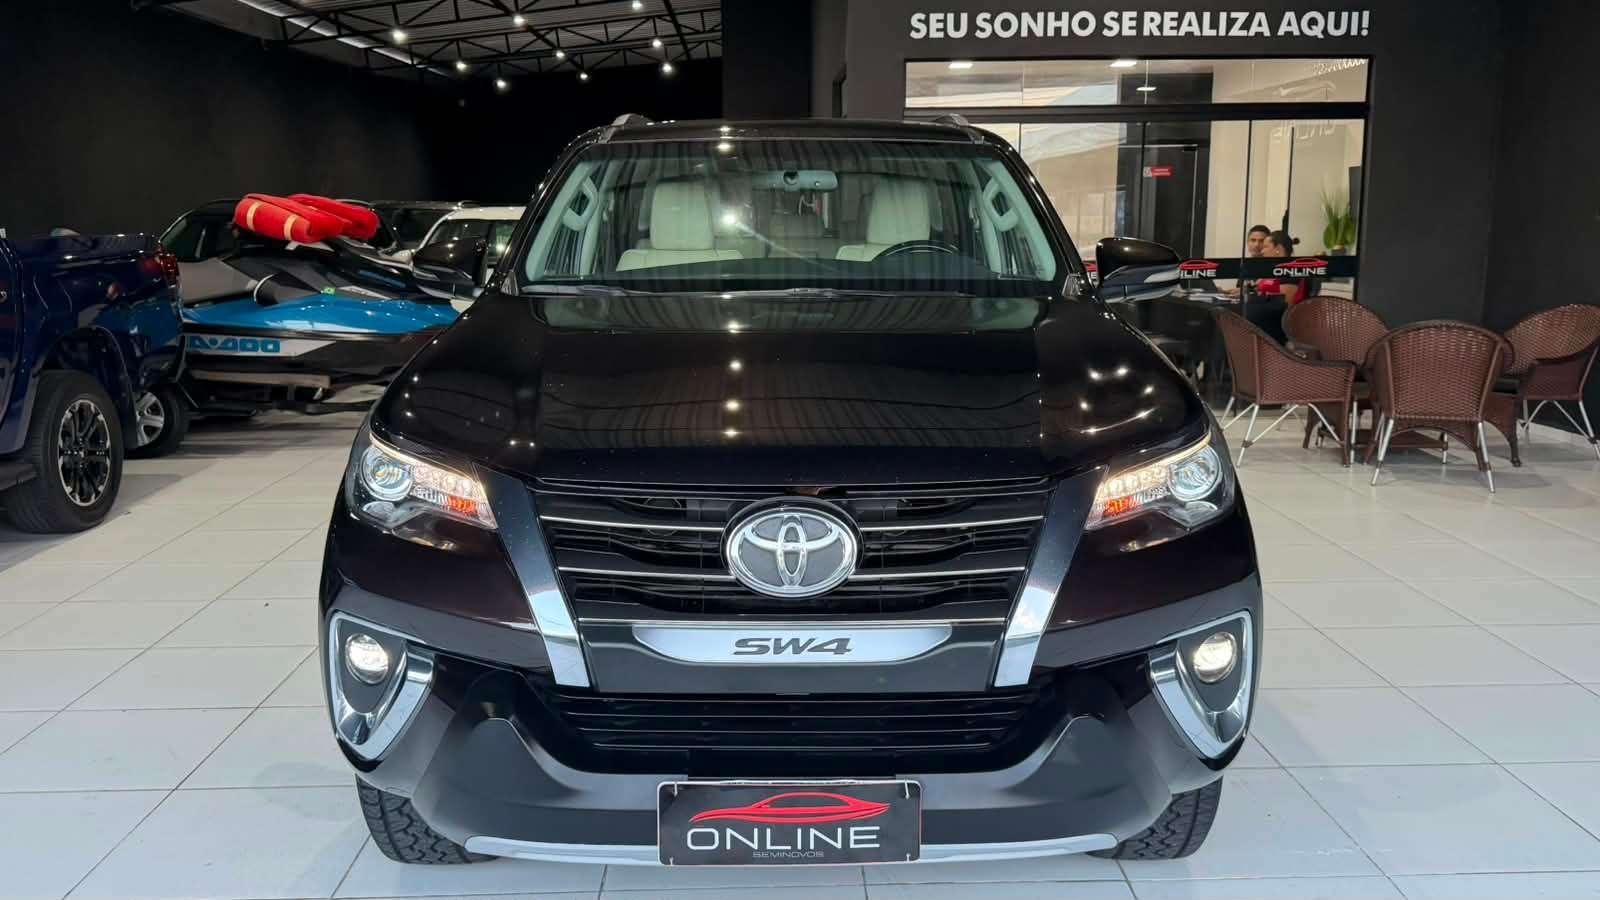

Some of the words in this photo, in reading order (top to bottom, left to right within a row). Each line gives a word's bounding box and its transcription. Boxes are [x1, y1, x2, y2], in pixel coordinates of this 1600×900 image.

[910, 12, 968, 39] SEU
[975, 10, 1096, 38] SONHO
[1102, 11, 1138, 37] SE
[1143, 11, 1271, 37] REALIZA
[1277, 10, 1370, 38] AQUI!
[1273, 267, 1327, 277] ONLINE
[733, 637, 852, 655] SW4
[687, 825, 880, 850] ONLINE
